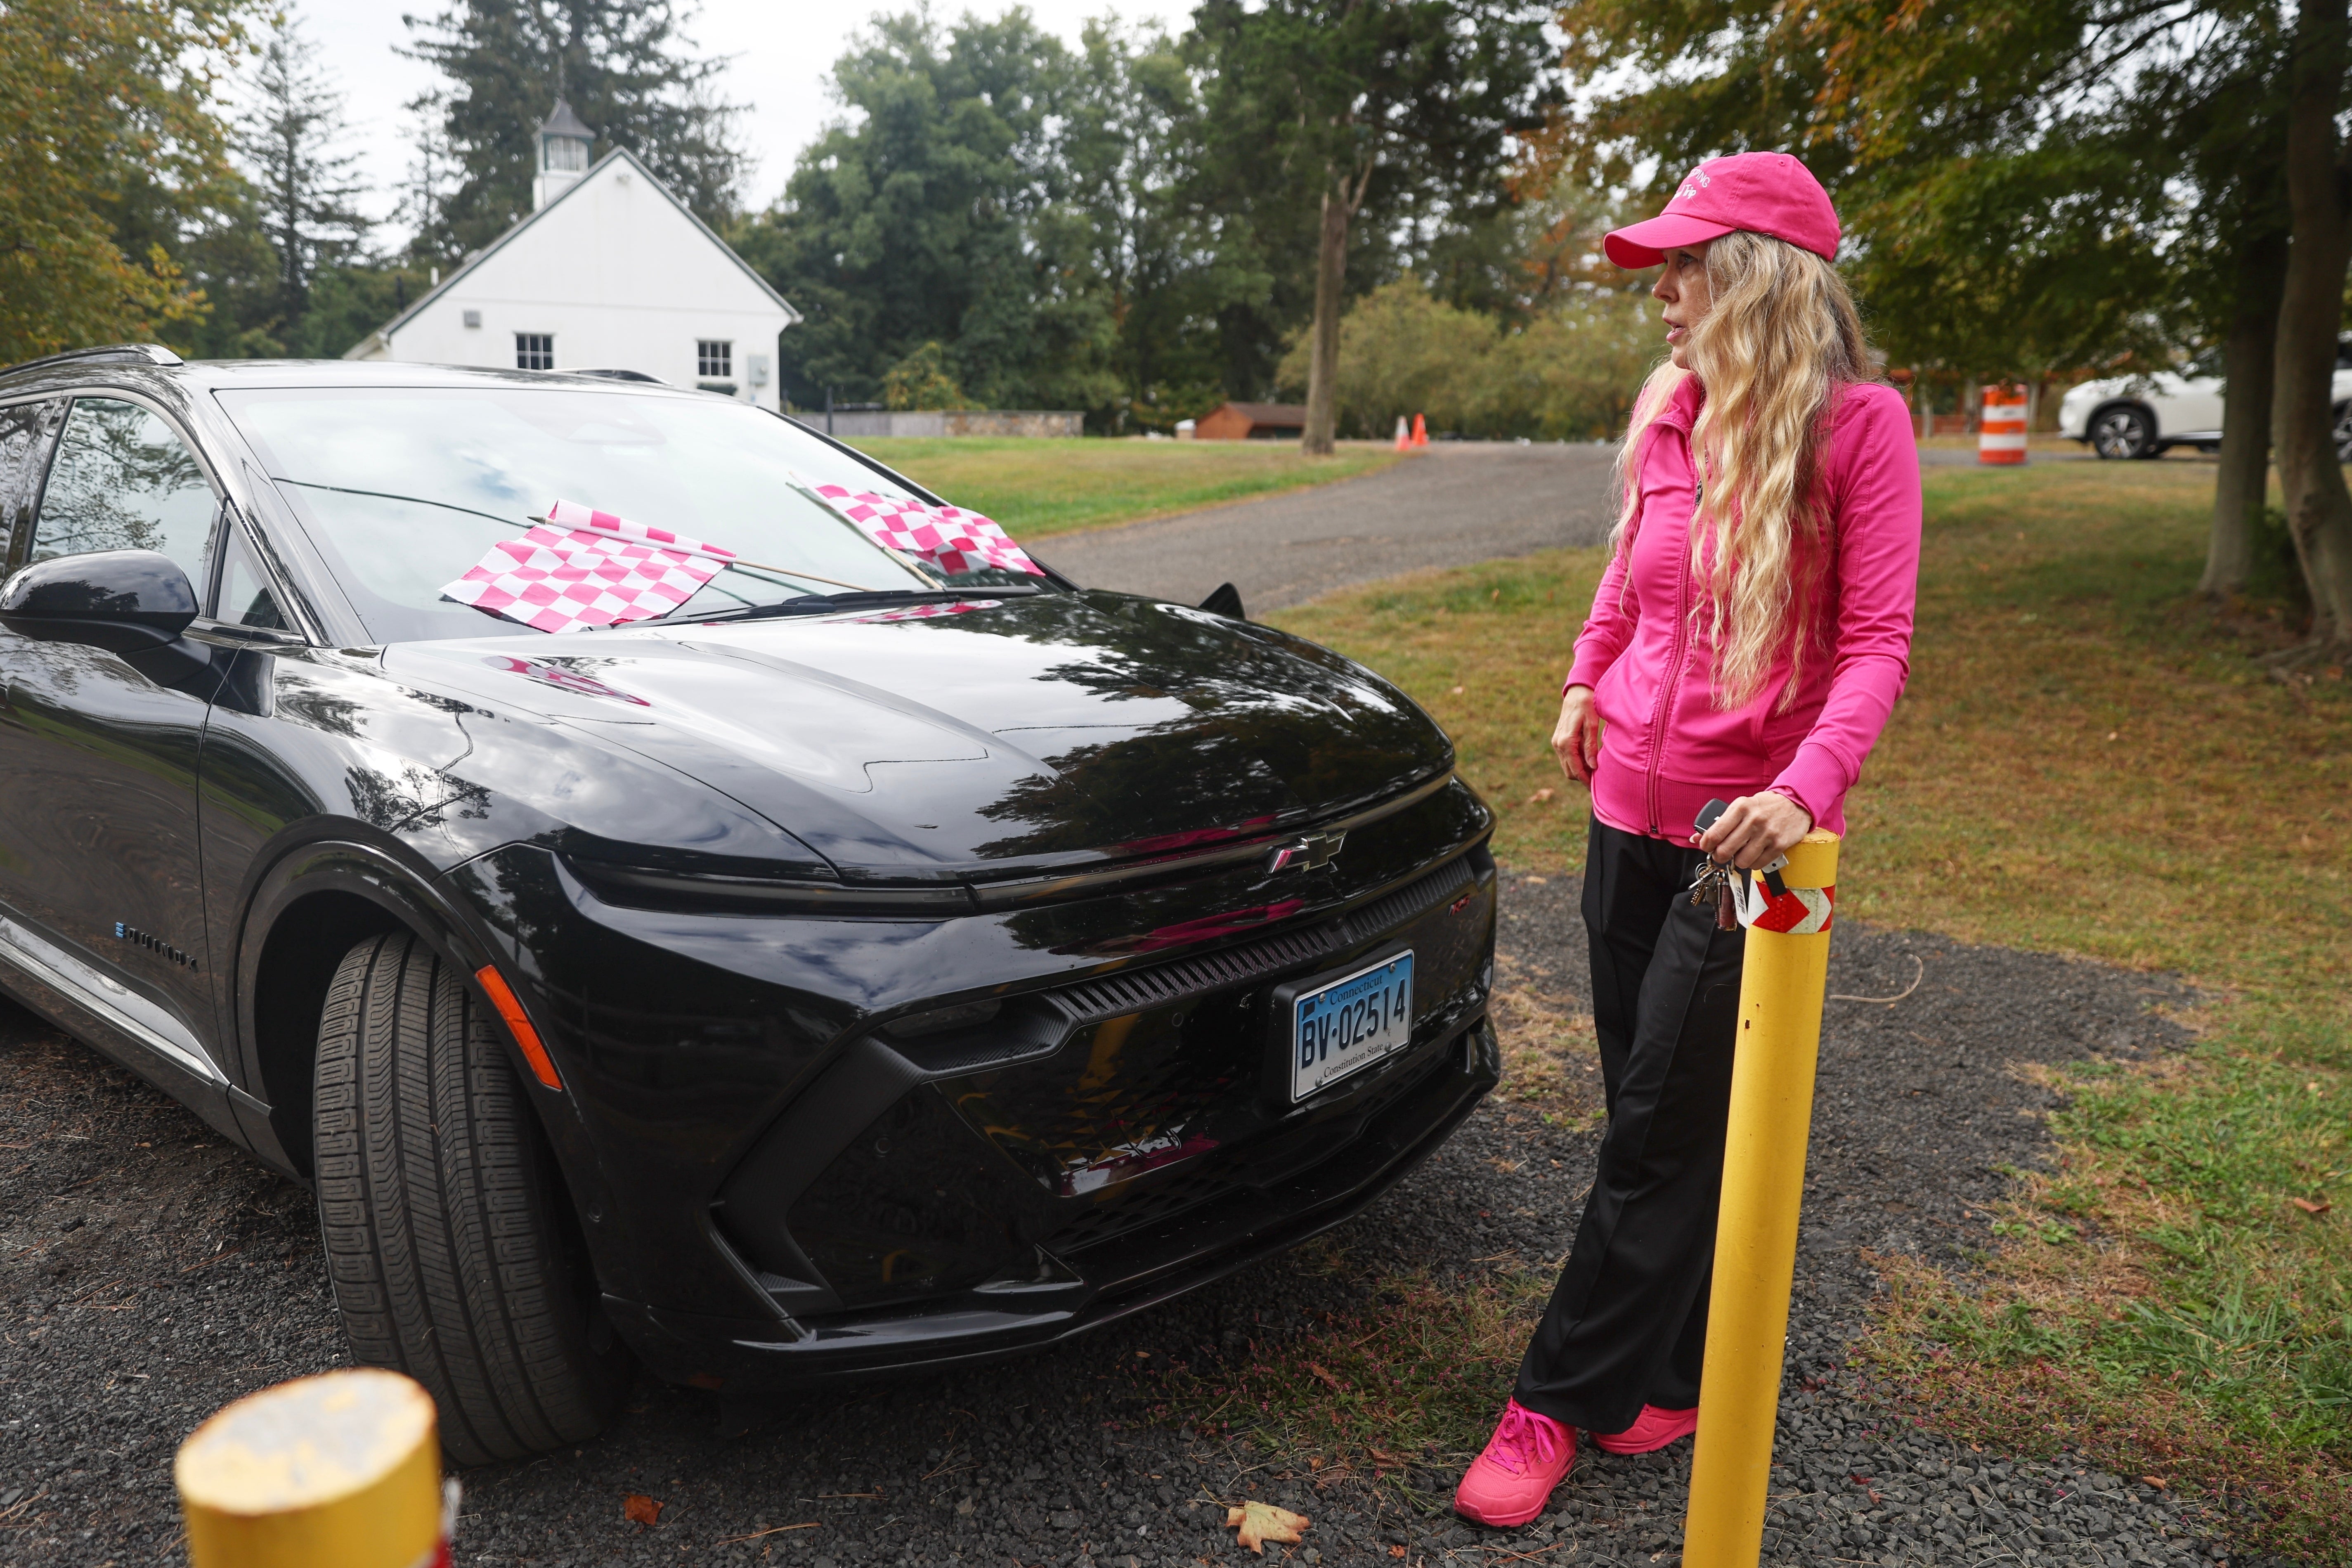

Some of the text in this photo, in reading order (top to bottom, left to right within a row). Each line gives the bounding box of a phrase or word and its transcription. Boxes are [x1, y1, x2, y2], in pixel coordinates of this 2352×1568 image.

[1683, 184, 1697, 199] Trip
[1330, 974, 1383, 1005] Connecticut
[1324, 1043, 1383, 1078] Constitution State
